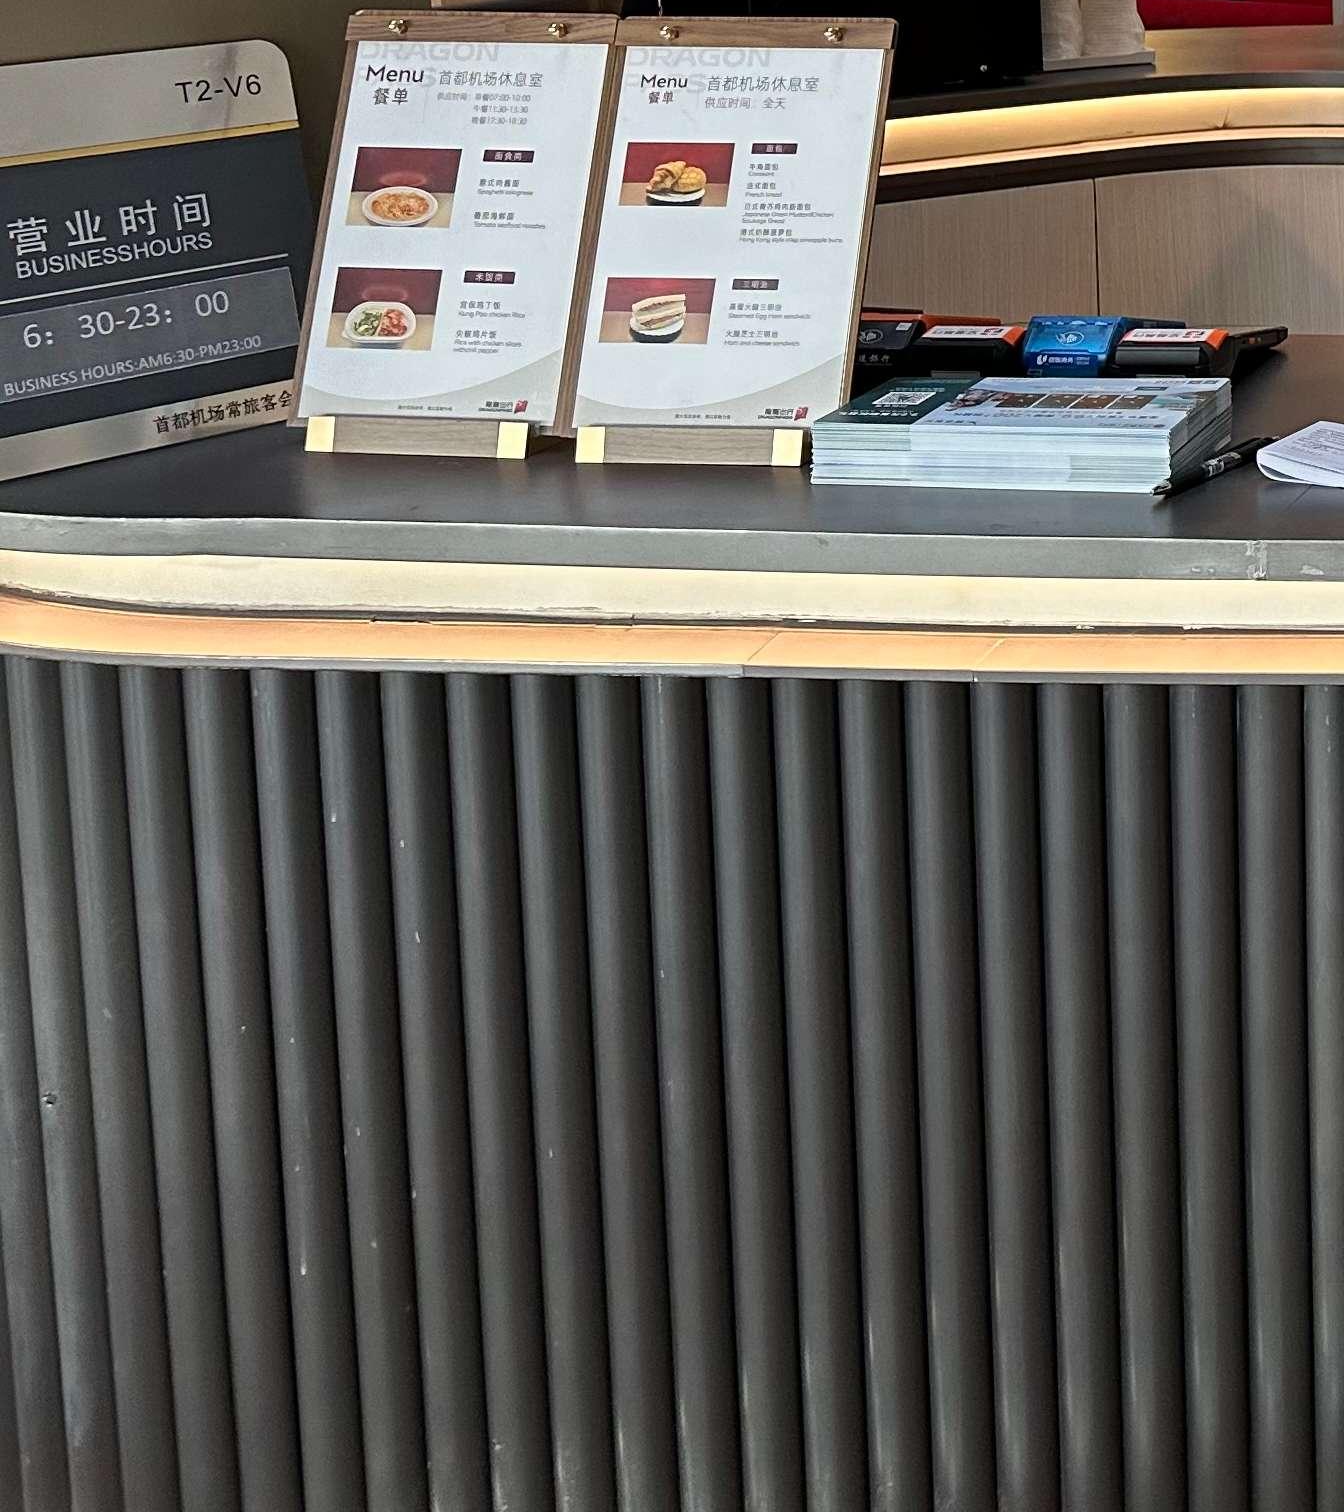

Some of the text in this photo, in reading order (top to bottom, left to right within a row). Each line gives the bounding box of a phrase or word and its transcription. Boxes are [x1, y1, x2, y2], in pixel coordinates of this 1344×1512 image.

[365, 64, 425, 83] Menu
[438, 70, 545, 88] 首都机场休息室
[639, 74, 689, 89] Menu
[174, 73, 263, 104] T2-V6
[706, 76, 821, 93] 首都机场休息室
[372, 87, 410, 106] 餐单
[648, 90, 674, 105] 餐单
[6, 192, 212, 257] 营业时间
[15, 232, 214, 280] BUSINESSHOURS
[3, 369, 79, 397] BUSINESS
